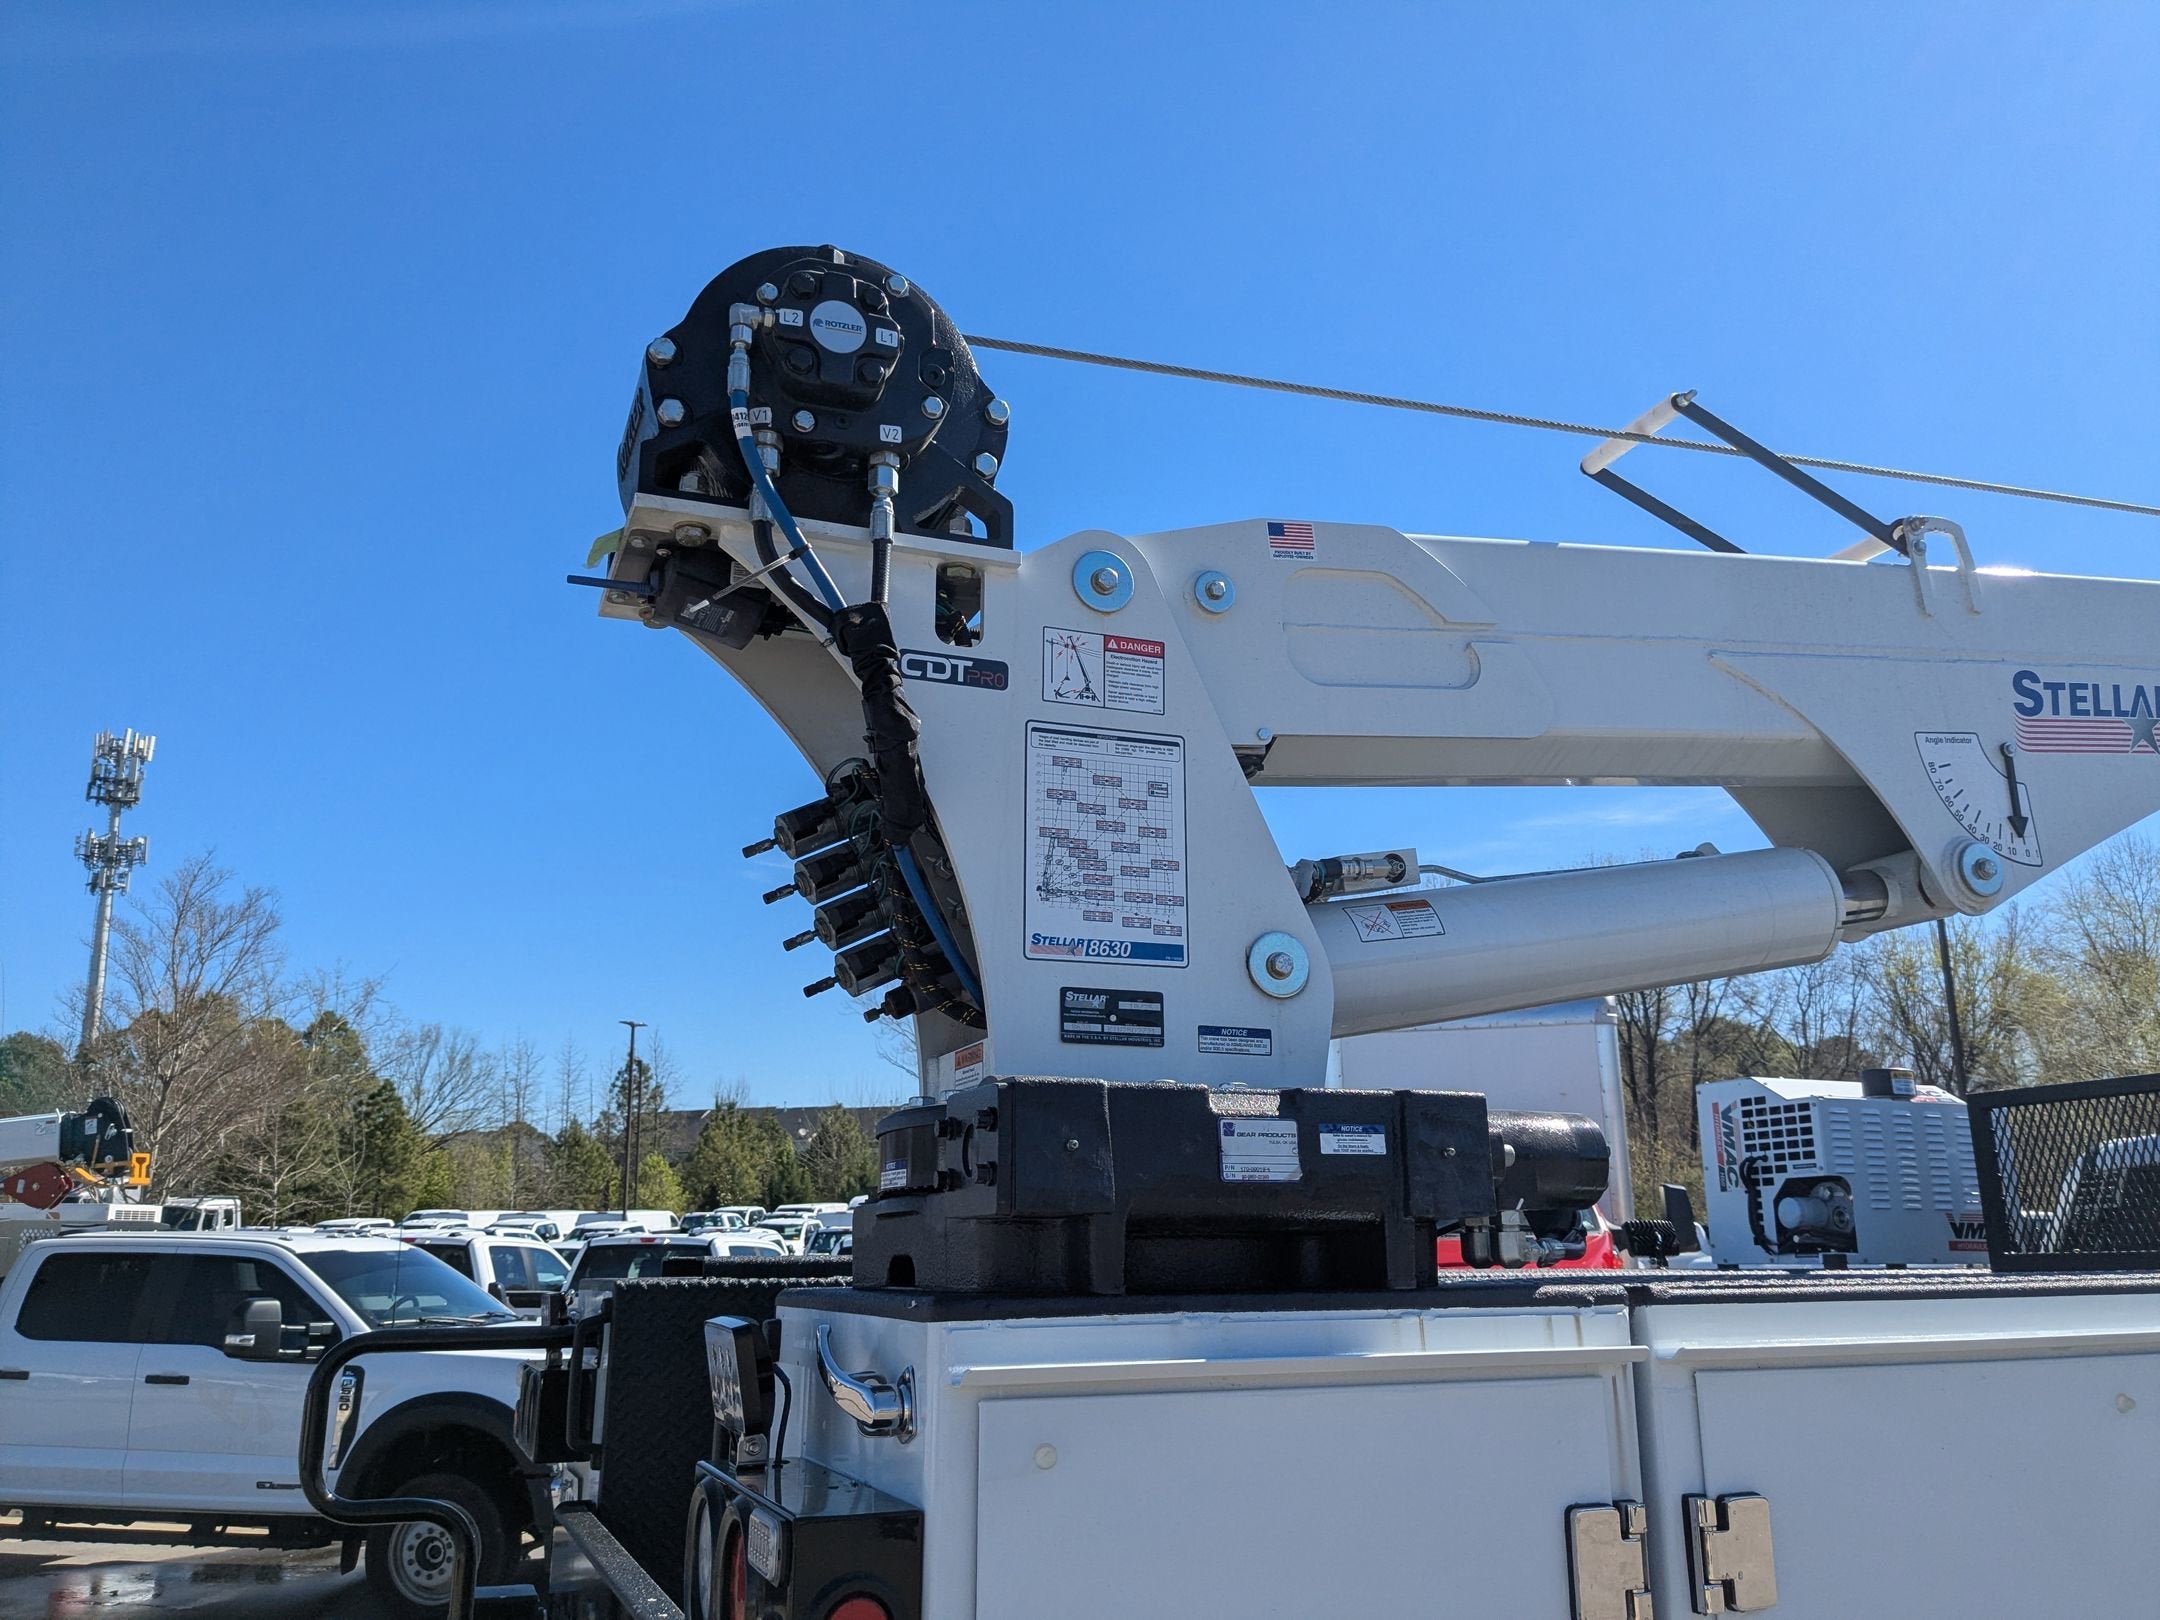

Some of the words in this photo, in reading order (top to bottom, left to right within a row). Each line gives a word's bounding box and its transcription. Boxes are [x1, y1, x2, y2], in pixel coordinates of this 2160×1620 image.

[783, 314, 799, 324] L2
[824, 320, 863, 333] ROTZLER
[880, 333, 894, 344] L1
[753, 410, 767, 421] V1
[882, 429, 899, 441] V2
[1120, 641, 1161, 654] DANGER
[901, 653, 974, 683] CDT
[967, 669, 1005, 688] PRO
[1925, 736, 1944, 745] Angle
[1928, 761, 1937, 774] 80
[1935, 778, 1944, 791] 70
[1944, 795, 1954, 808] 60
[1954, 809, 1965, 821] 50
[1967, 823, 1977, 834] 40
[1980, 833, 1990, 844] 30
[1993, 842, 2003, 852] 20
[2008, 846, 2017, 856] 10
[1031, 932, 1084, 947] STELLAR
[1088, 940, 1132, 957] 8630
[1065, 991, 1106, 1003] STELLAR
[1221, 1028, 1248, 1037] NOTICE
[1720, 1102, 1740, 1188] VMAC
